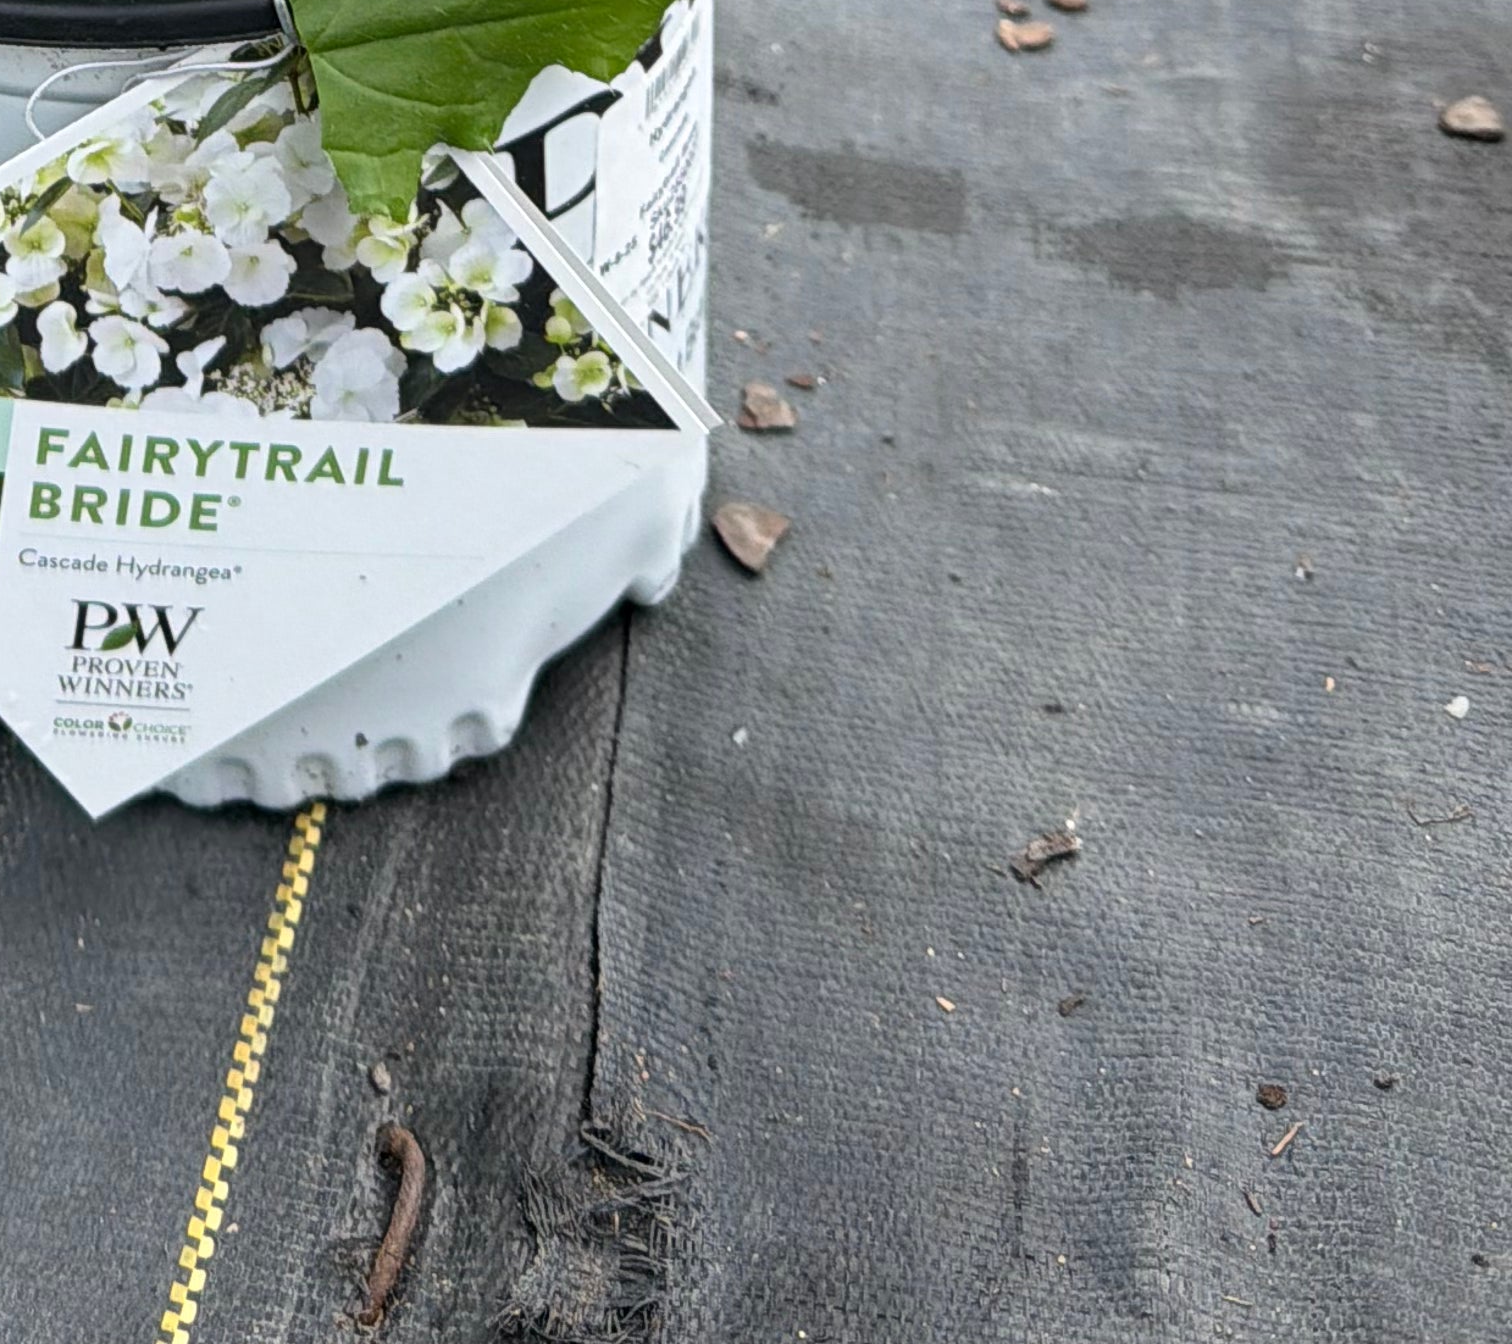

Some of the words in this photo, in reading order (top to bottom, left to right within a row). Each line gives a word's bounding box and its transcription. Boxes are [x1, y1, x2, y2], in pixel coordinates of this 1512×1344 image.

[35, 426, 405, 488] FAIRYTRAIL
[18, 547, 109, 573] Cascade
[64, 598, 206, 657] PW
[71, 655, 180, 679] PROVEN
[52, 716, 105, 730] COLOR
